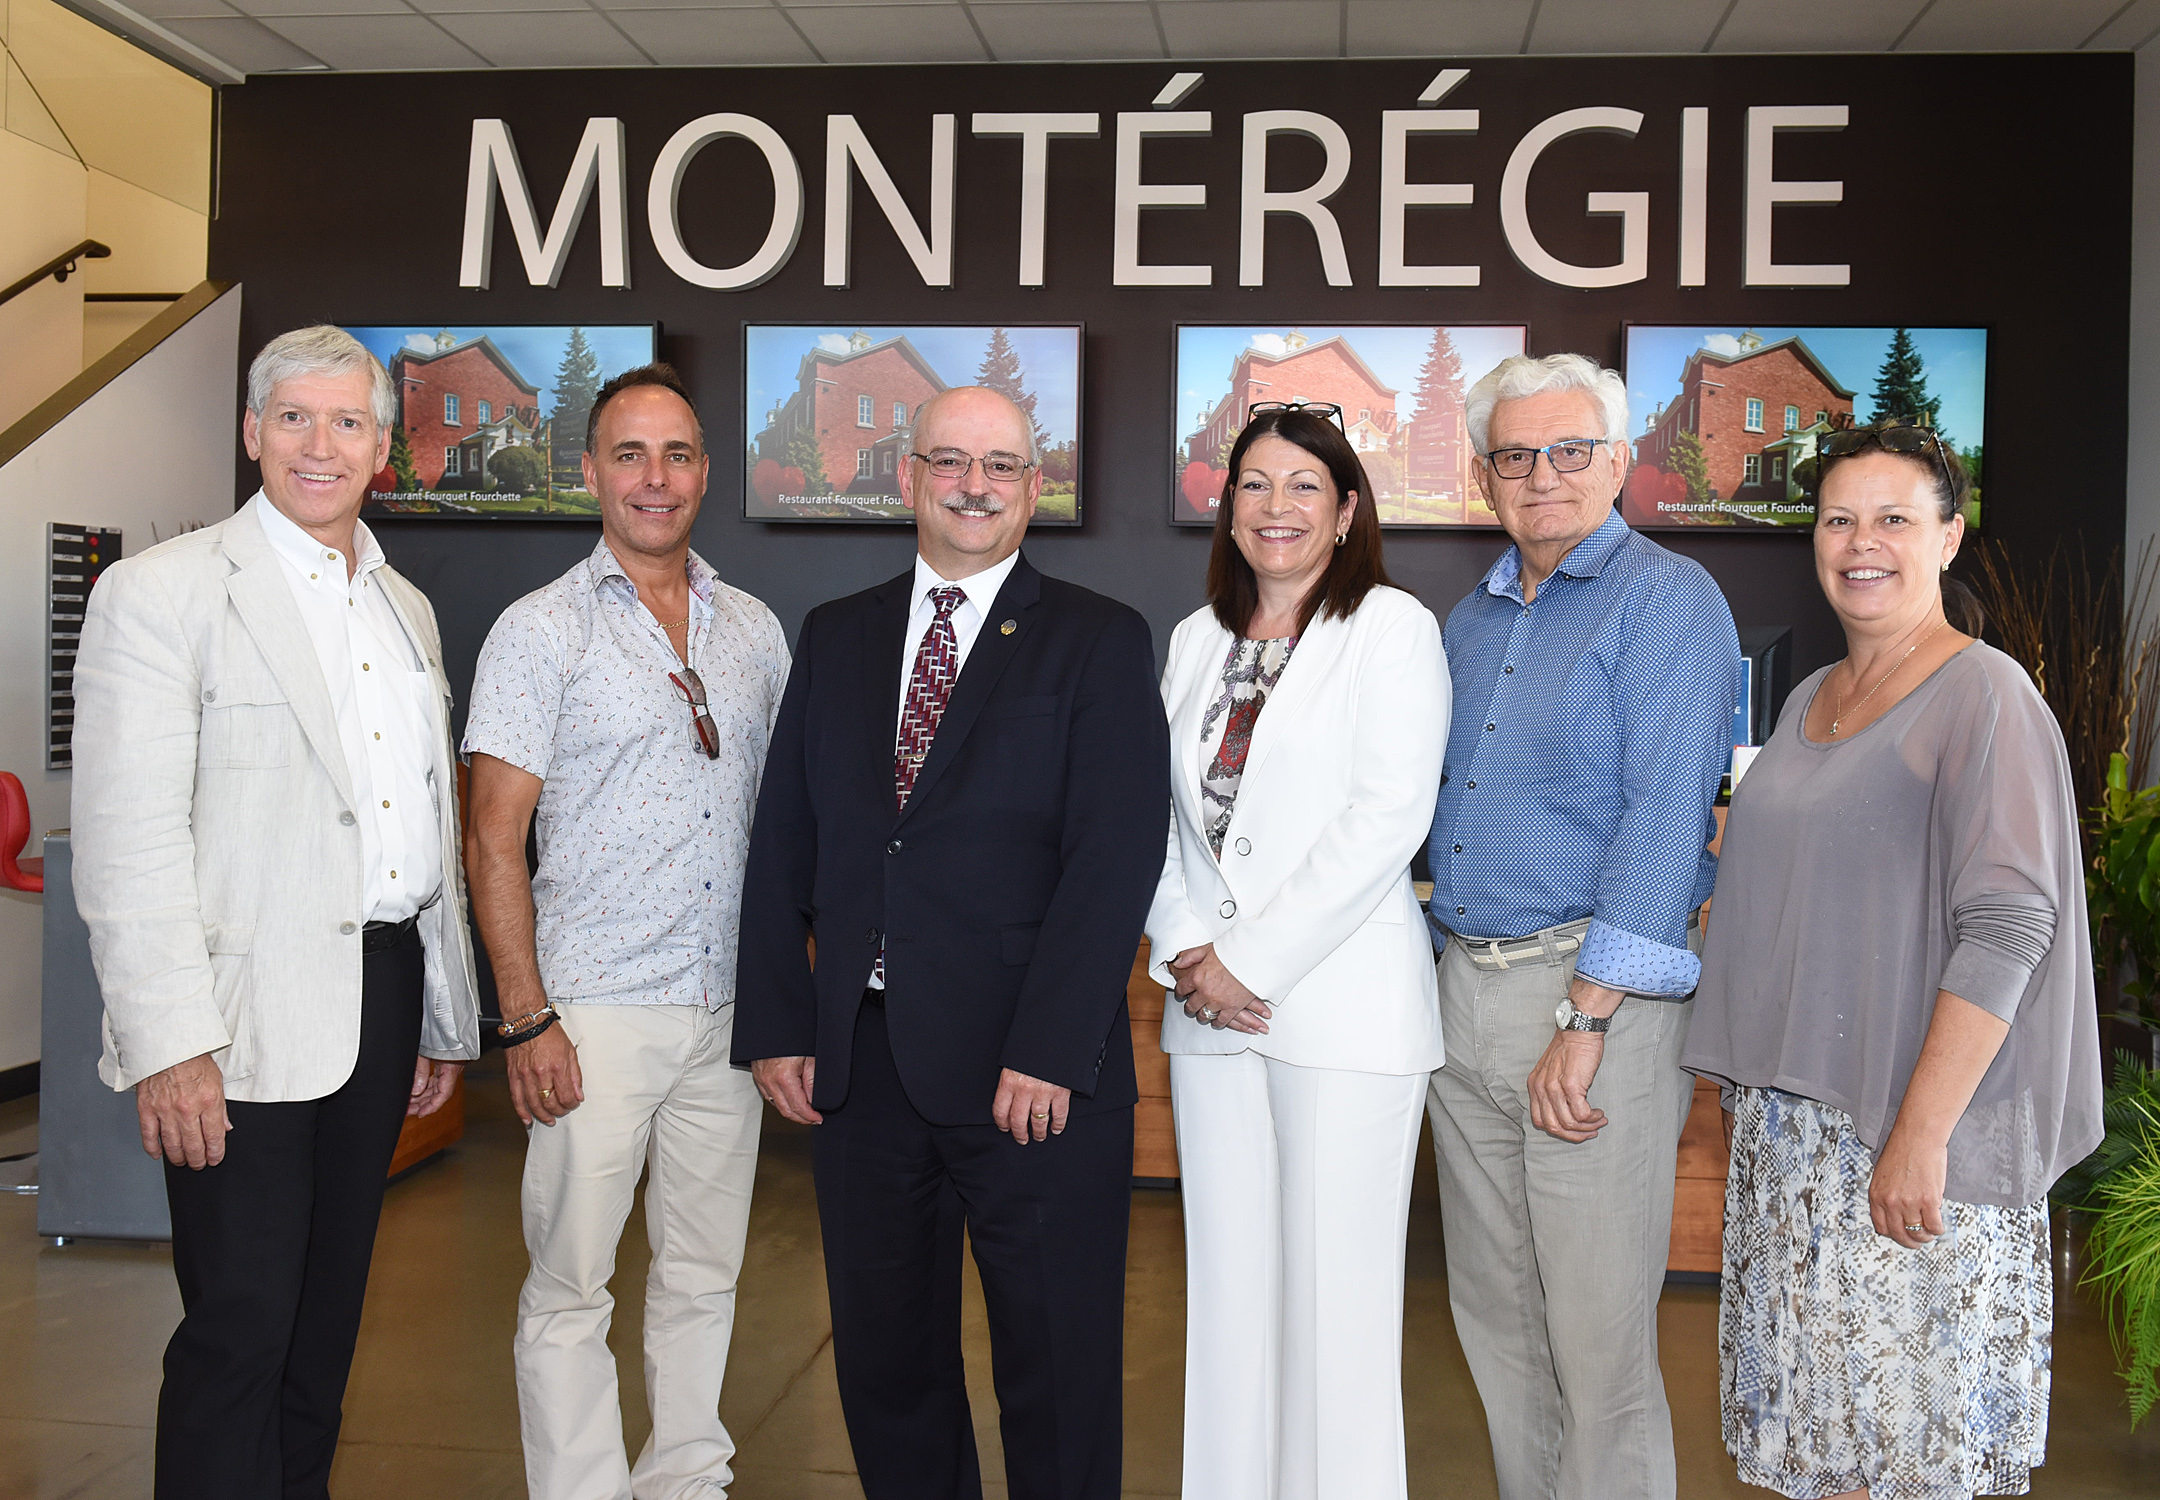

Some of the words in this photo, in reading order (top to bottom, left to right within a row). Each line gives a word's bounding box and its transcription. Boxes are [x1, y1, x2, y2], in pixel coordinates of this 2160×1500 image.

[459, 69, 1851, 291] MONTÉRÉGIE
[371, 490, 422, 501] Restaurant
[425, 491, 468, 502] Fourquet
[470, 491, 521, 502] Fourchette
[778, 494, 832, 505] Restaurant
[835, 494, 880, 506] Fourquet
[1657, 501, 1716, 512] Restaurant
[1719, 502, 1768, 515] Fourquet
[1771, 502, 1815, 513] Fourche
